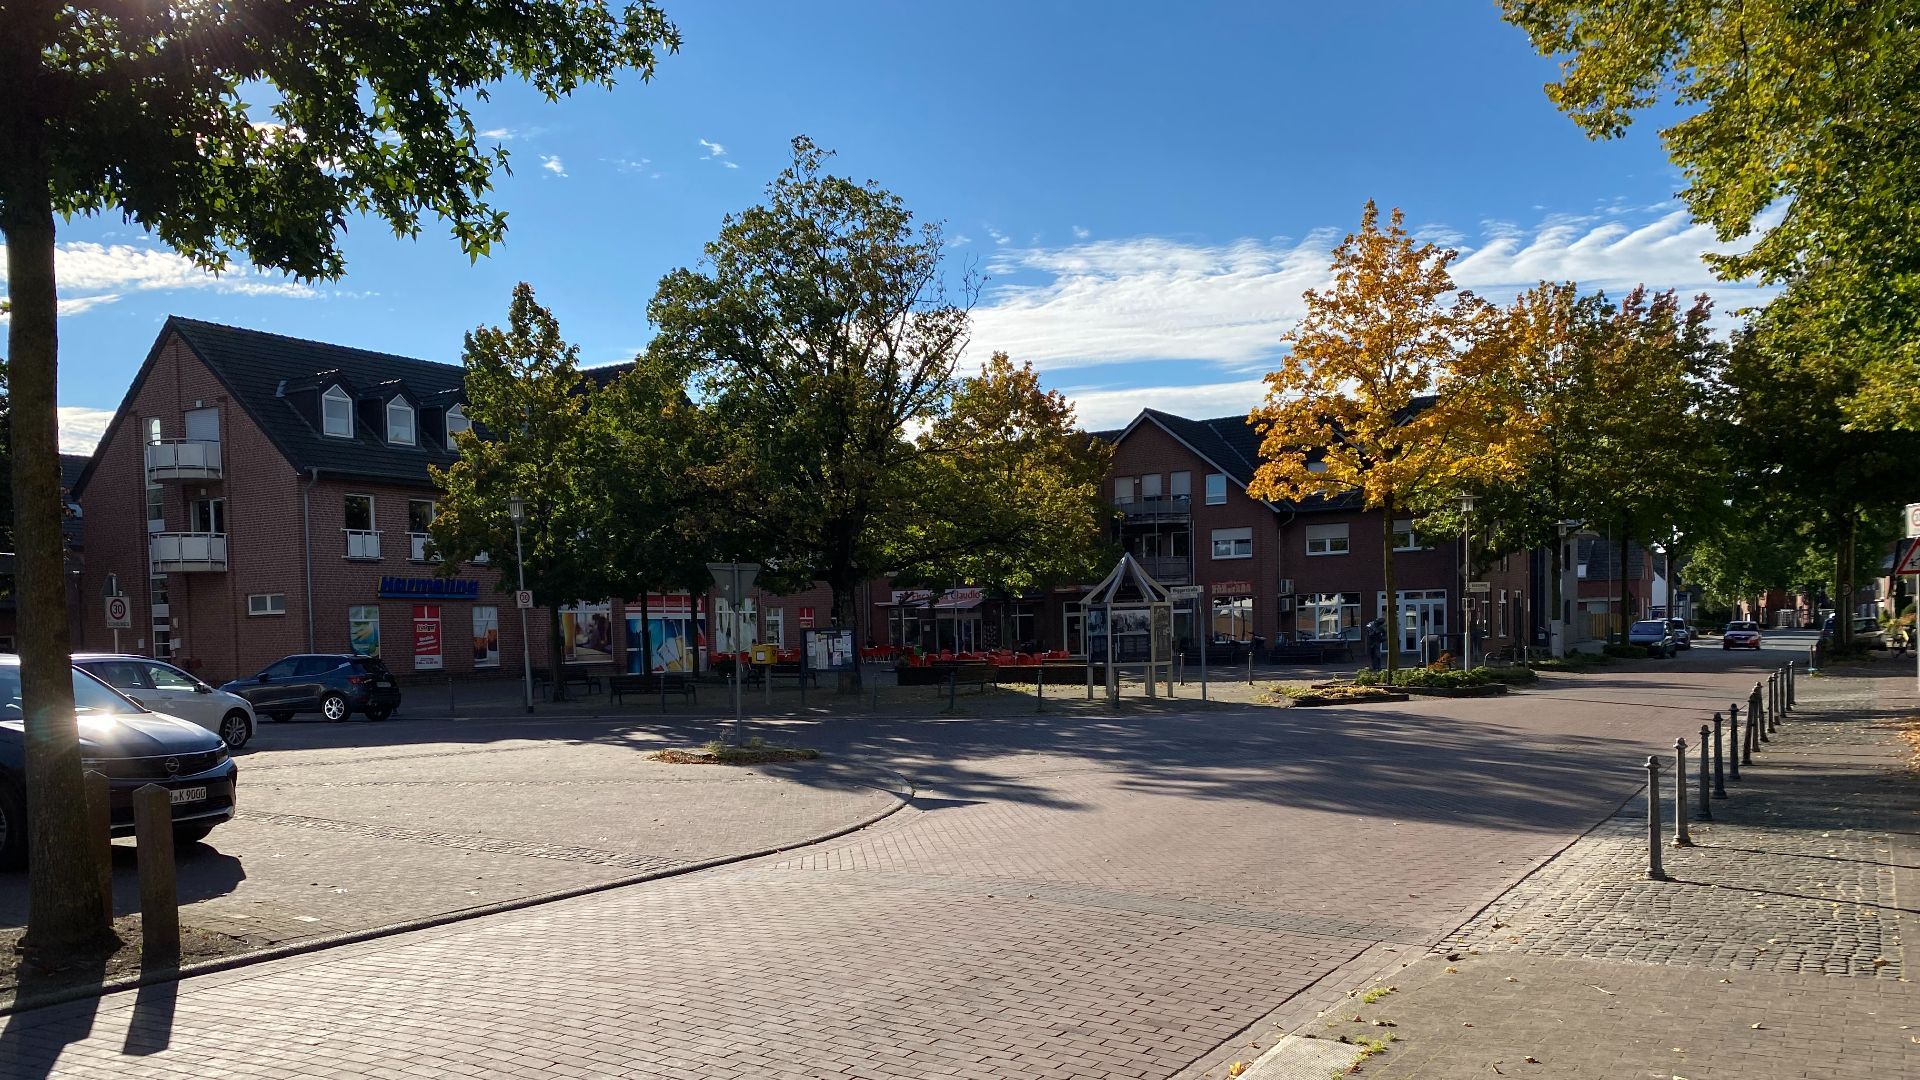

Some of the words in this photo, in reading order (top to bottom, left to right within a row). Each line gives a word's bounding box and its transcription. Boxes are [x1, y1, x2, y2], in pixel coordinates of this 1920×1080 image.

[950, 589, 981, 600] Claudio
[113, 604, 123, 614] 30
[187, 788, 206, 800] 9000
